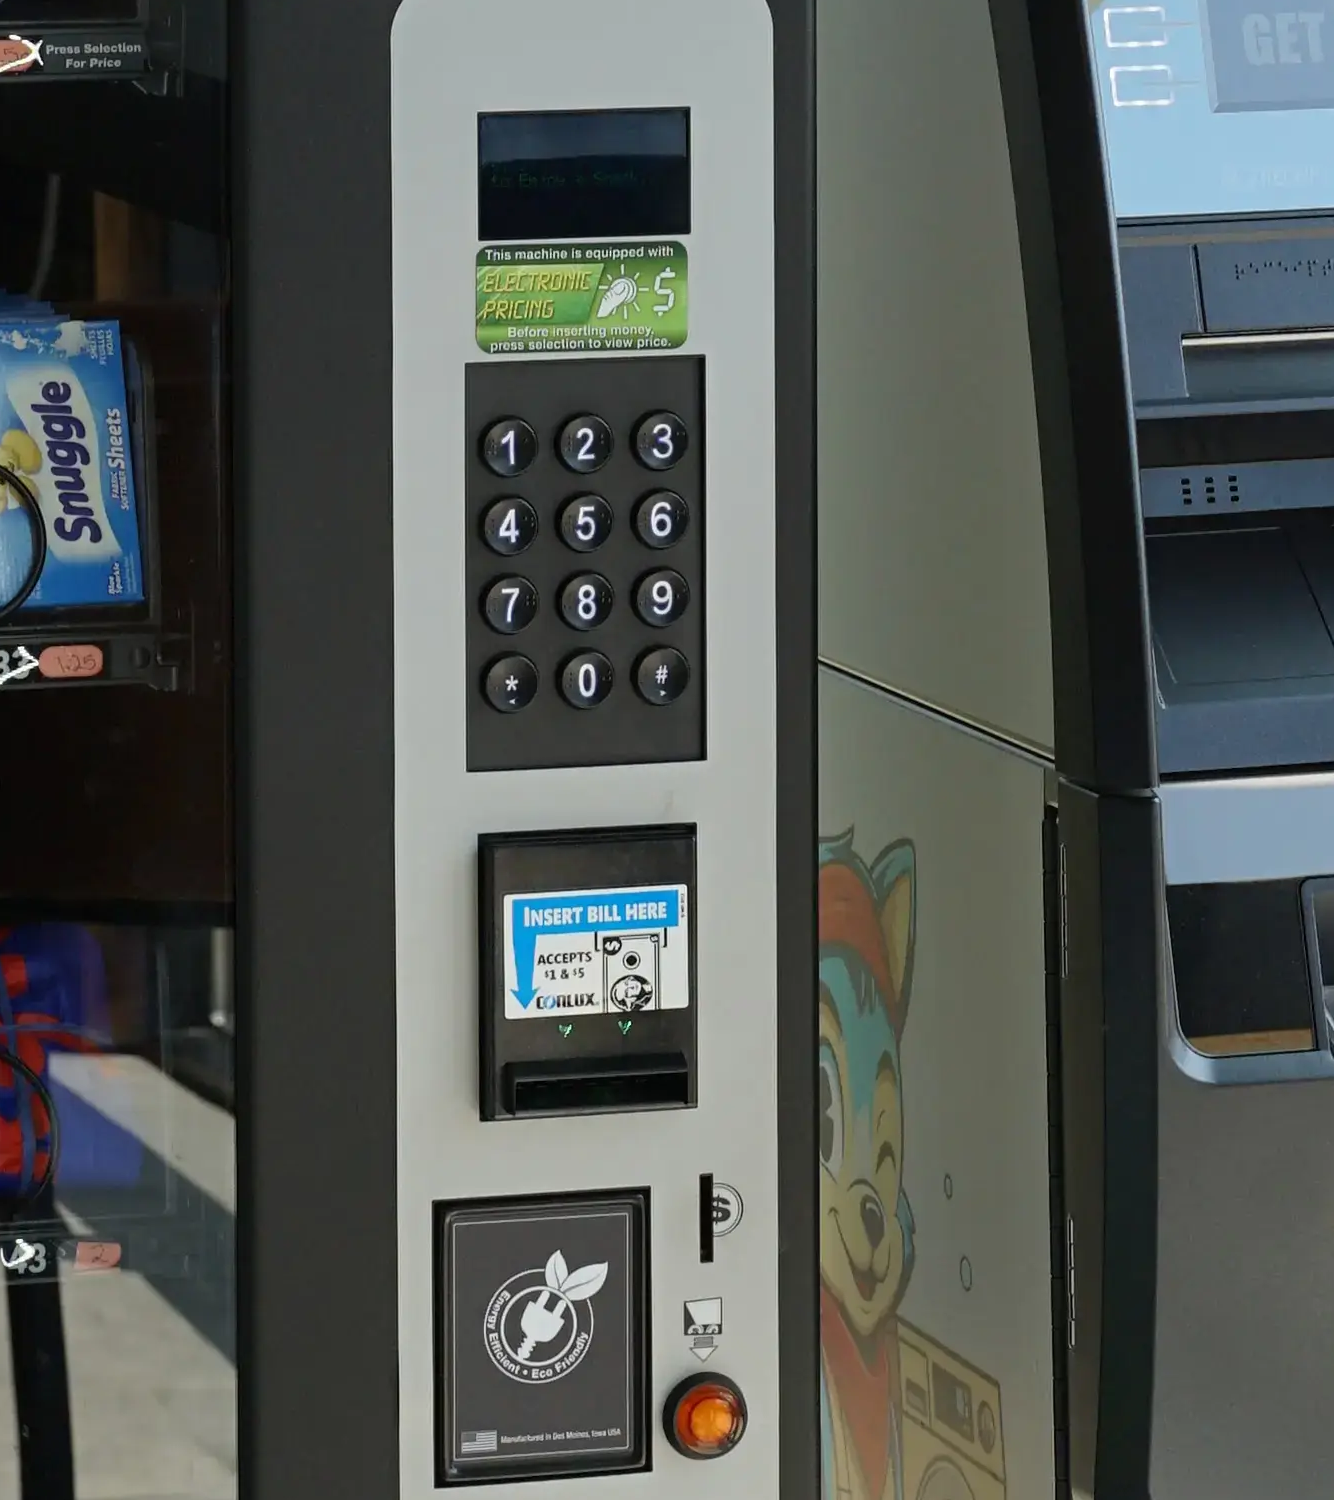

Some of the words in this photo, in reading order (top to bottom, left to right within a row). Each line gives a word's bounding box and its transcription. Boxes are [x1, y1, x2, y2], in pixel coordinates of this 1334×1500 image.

[46, 45, 81, 55] Press
[84, 42, 142, 54] Selection
[1242, 10, 1325, 66] GET
[66, 58, 89, 69] For
[93, 57, 122, 68] Price
[485, 249, 511, 261] This
[515, 247, 567, 260] machine
[571, 247, 582, 258] is
[585, 246, 644, 261] equipped
[648, 245, 674, 258] with
[482, 271, 592, 294] ELECTRONIC
[482, 299, 554, 320] PRICING
[490, 340, 525, 353] press
[528, 338, 584, 351] selection
[588, 338, 601, 349] to
[605, 337, 632, 349] view
[637, 336, 672, 350] price.
[507, 326, 549, 338] Before
[552, 325, 606, 339] inserting
[107, 408, 125, 469] Sheets
[501, 430, 515, 464] 1
[576, 427, 595, 460] 2
[652, 424, 673, 459] 3
[31, 380, 102, 544] Snuggle
[499, 509, 519, 543] 4
[575, 506, 595, 541] 5
[650, 502, 672, 537] 6
[501, 588, 519, 623] 7
[577, 585, 597, 620] 8
[652, 581, 673, 615] 9
[578, 663, 597, 697] 0
[524, 906, 584, 928] INSERT
[587, 904, 622, 924] BILL
[625, 901, 667, 921] HERE
[537, 951, 592, 966] ACCEPTS
[544, 968, 556, 980] $1
[560, 968, 569, 979] &
[573, 967, 585, 978] $5
[536, 992, 597, 1010] CONLUX
[9, 1242, 47, 1275] 43
[487, 1290, 511, 1330] Energy
[488, 1331, 522, 1375] Efficient
[554, 1331, 589, 1374] Friendly
[531, 1367, 553, 1379] Eco
[607, 1428, 621, 1437] USA
